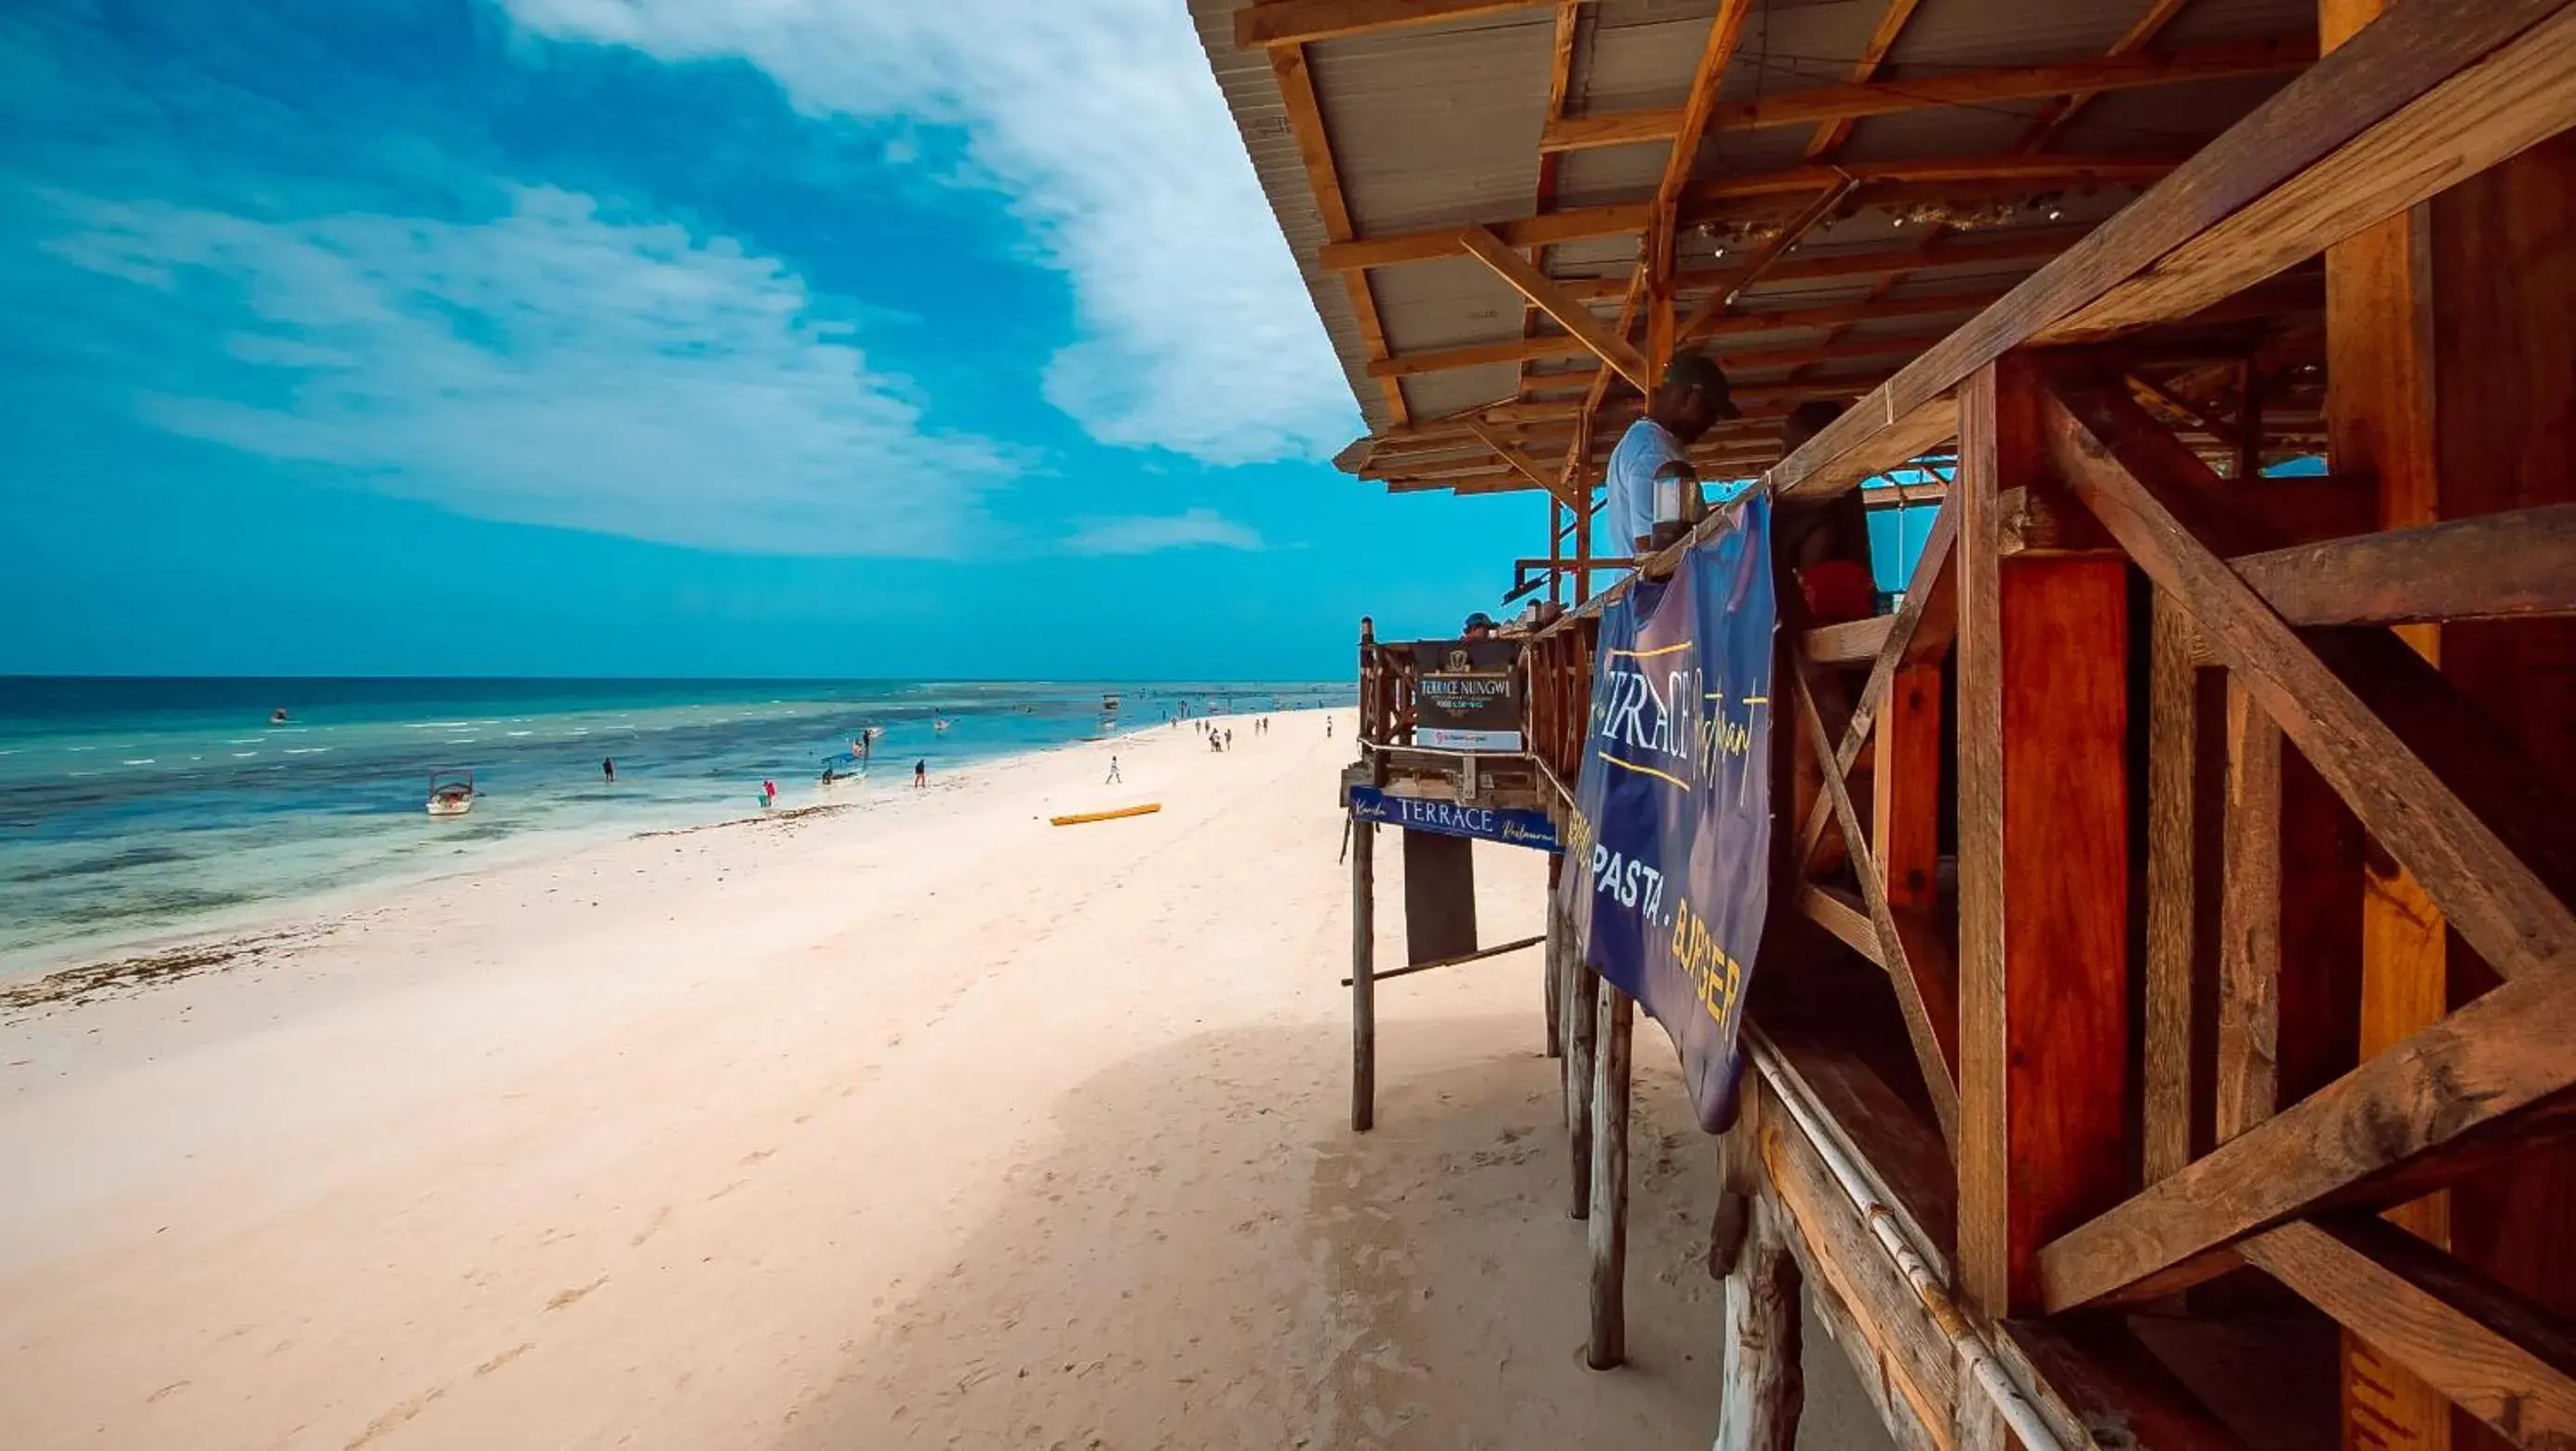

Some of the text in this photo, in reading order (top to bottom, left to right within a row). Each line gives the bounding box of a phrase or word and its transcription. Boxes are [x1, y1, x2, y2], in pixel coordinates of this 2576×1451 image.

[1461, 679, 1510, 698] NUNGWI
[1396, 798, 1493, 832] TERRACE
[1591, 842, 1741, 1042] PASTA BURGER
